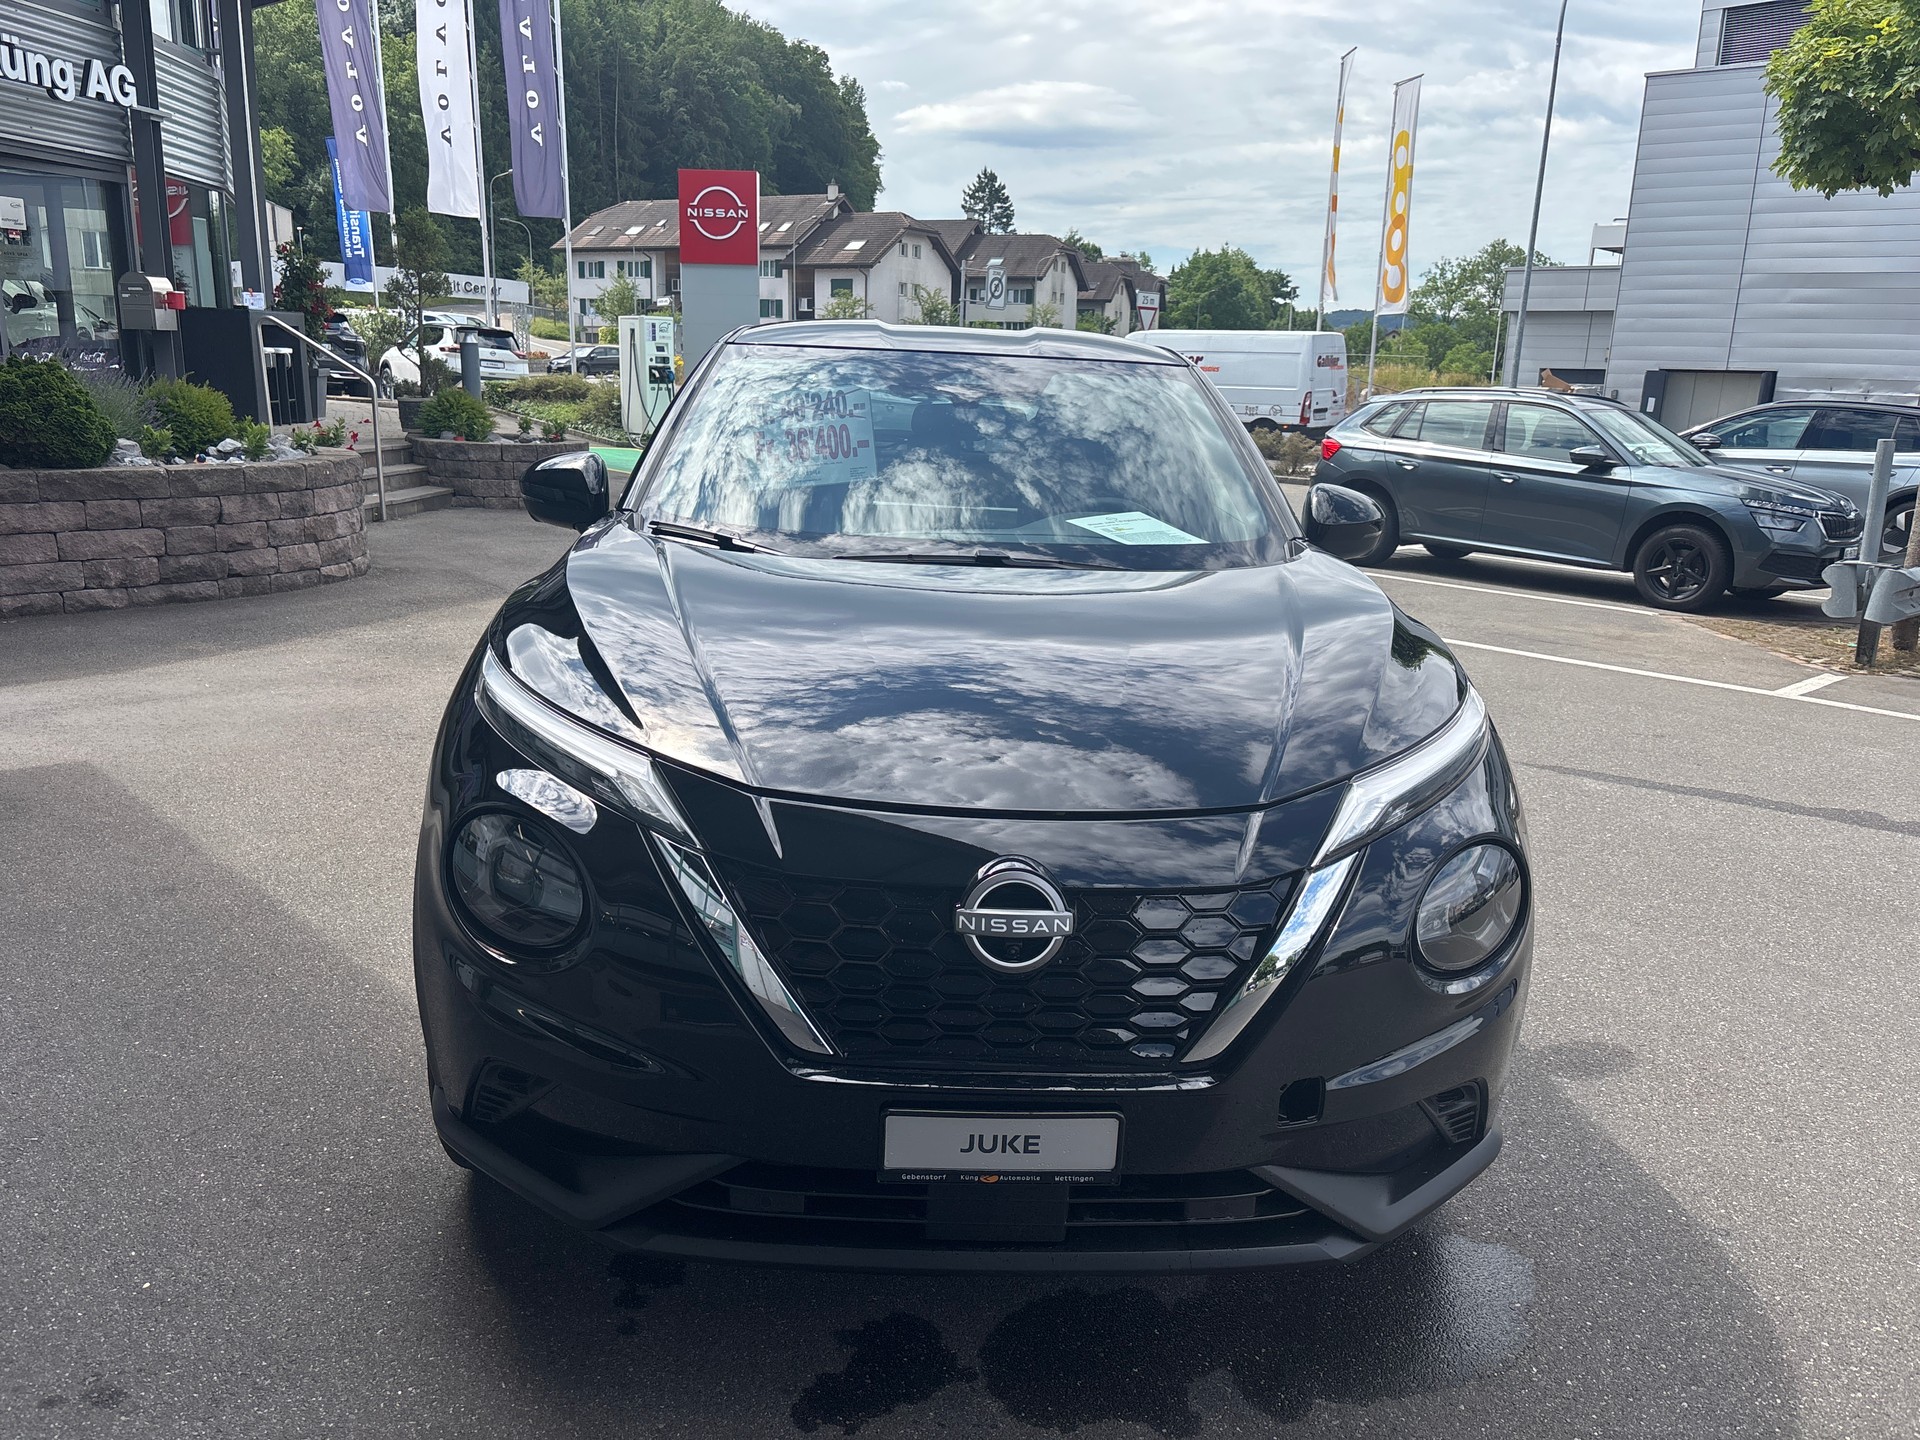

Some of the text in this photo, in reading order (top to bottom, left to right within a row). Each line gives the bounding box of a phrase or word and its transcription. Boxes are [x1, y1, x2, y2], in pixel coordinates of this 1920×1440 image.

[0, 33, 138, 108] üng AG
[686, 207, 749, 219] NISSAN
[463, 281, 503, 295] Cener
[958, 915, 1070, 933] NISSAN
[960, 1134, 1041, 1154] JUKE
[901, 1173, 947, 1181] Gebenstorf
[960, 1174, 979, 1182] Küng
[1054, 1175, 1095, 1183] Wettingen
